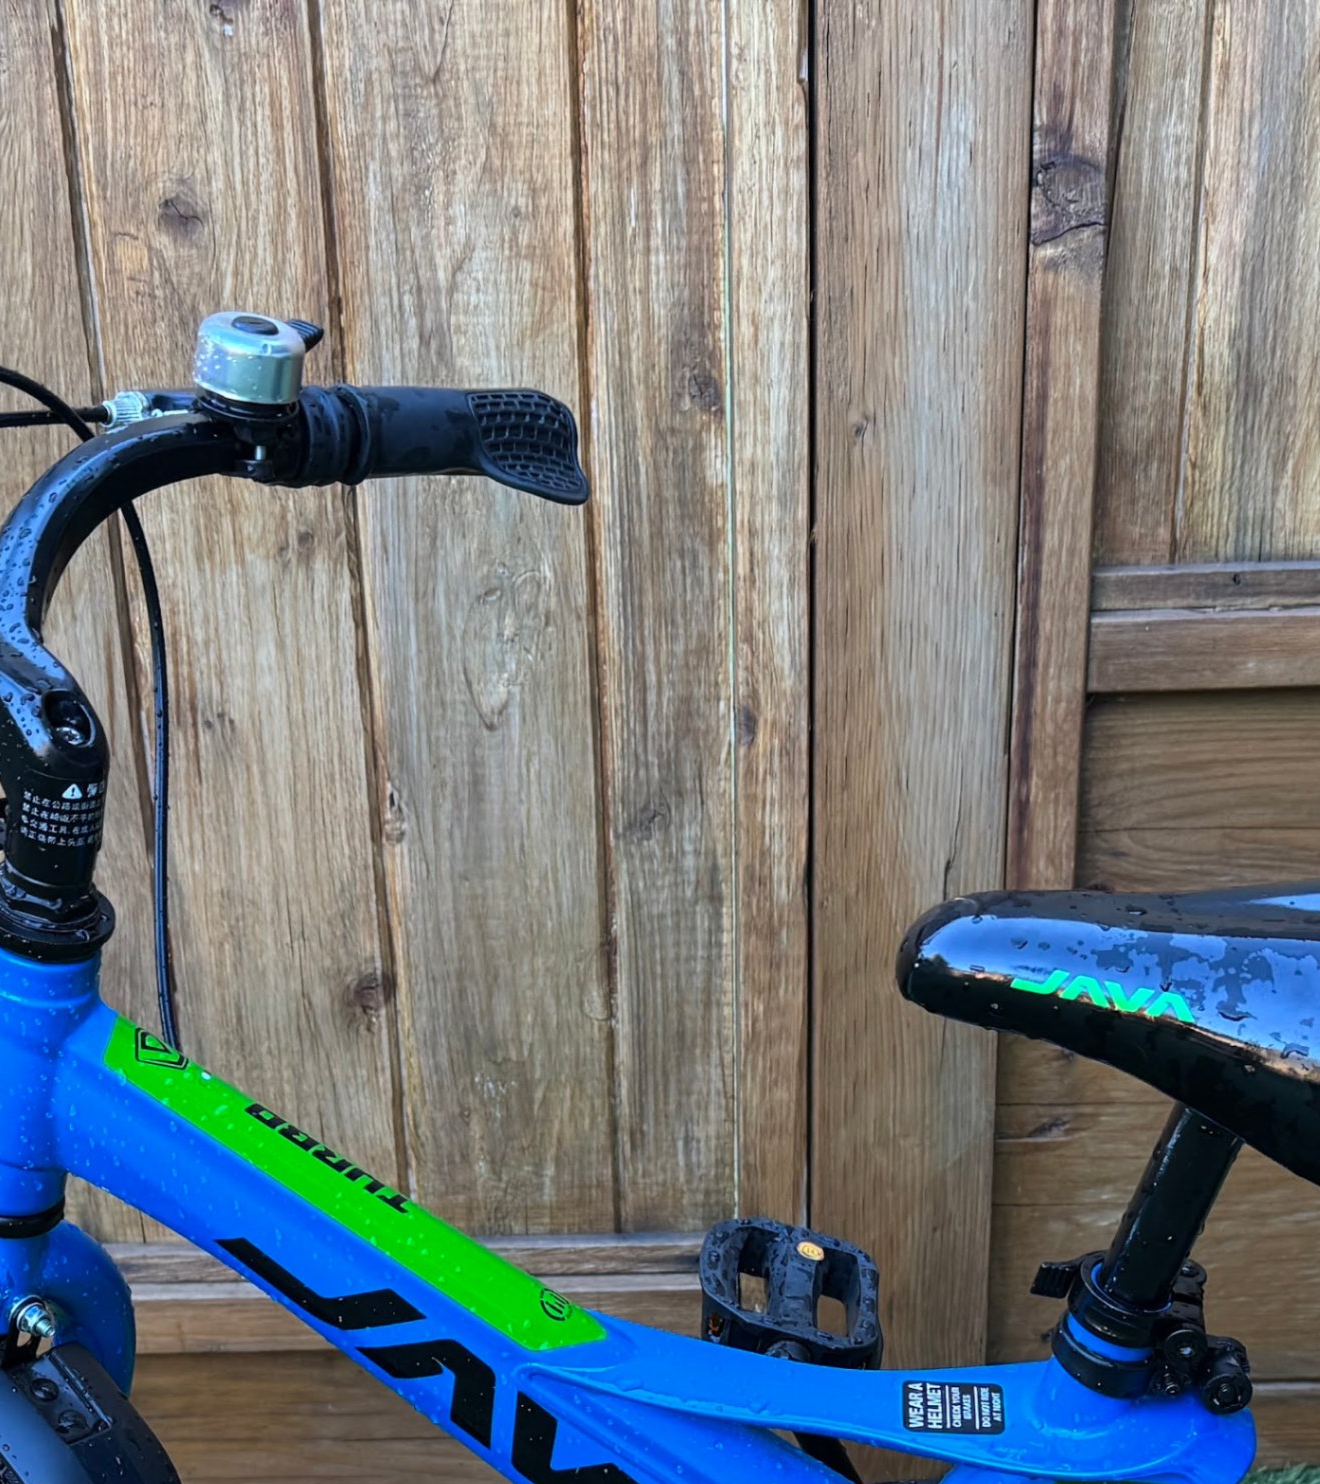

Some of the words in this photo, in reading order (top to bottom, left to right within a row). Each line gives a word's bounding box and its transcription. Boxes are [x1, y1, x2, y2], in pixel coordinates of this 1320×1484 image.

[1010, 969, 1196, 1024] JAVA
[244, 1103, 410, 1214] TURBO
[908, 1382, 923, 1391] A
[908, 1391, 924, 1428] WEAR
[926, 1383, 943, 1429] HELMET
